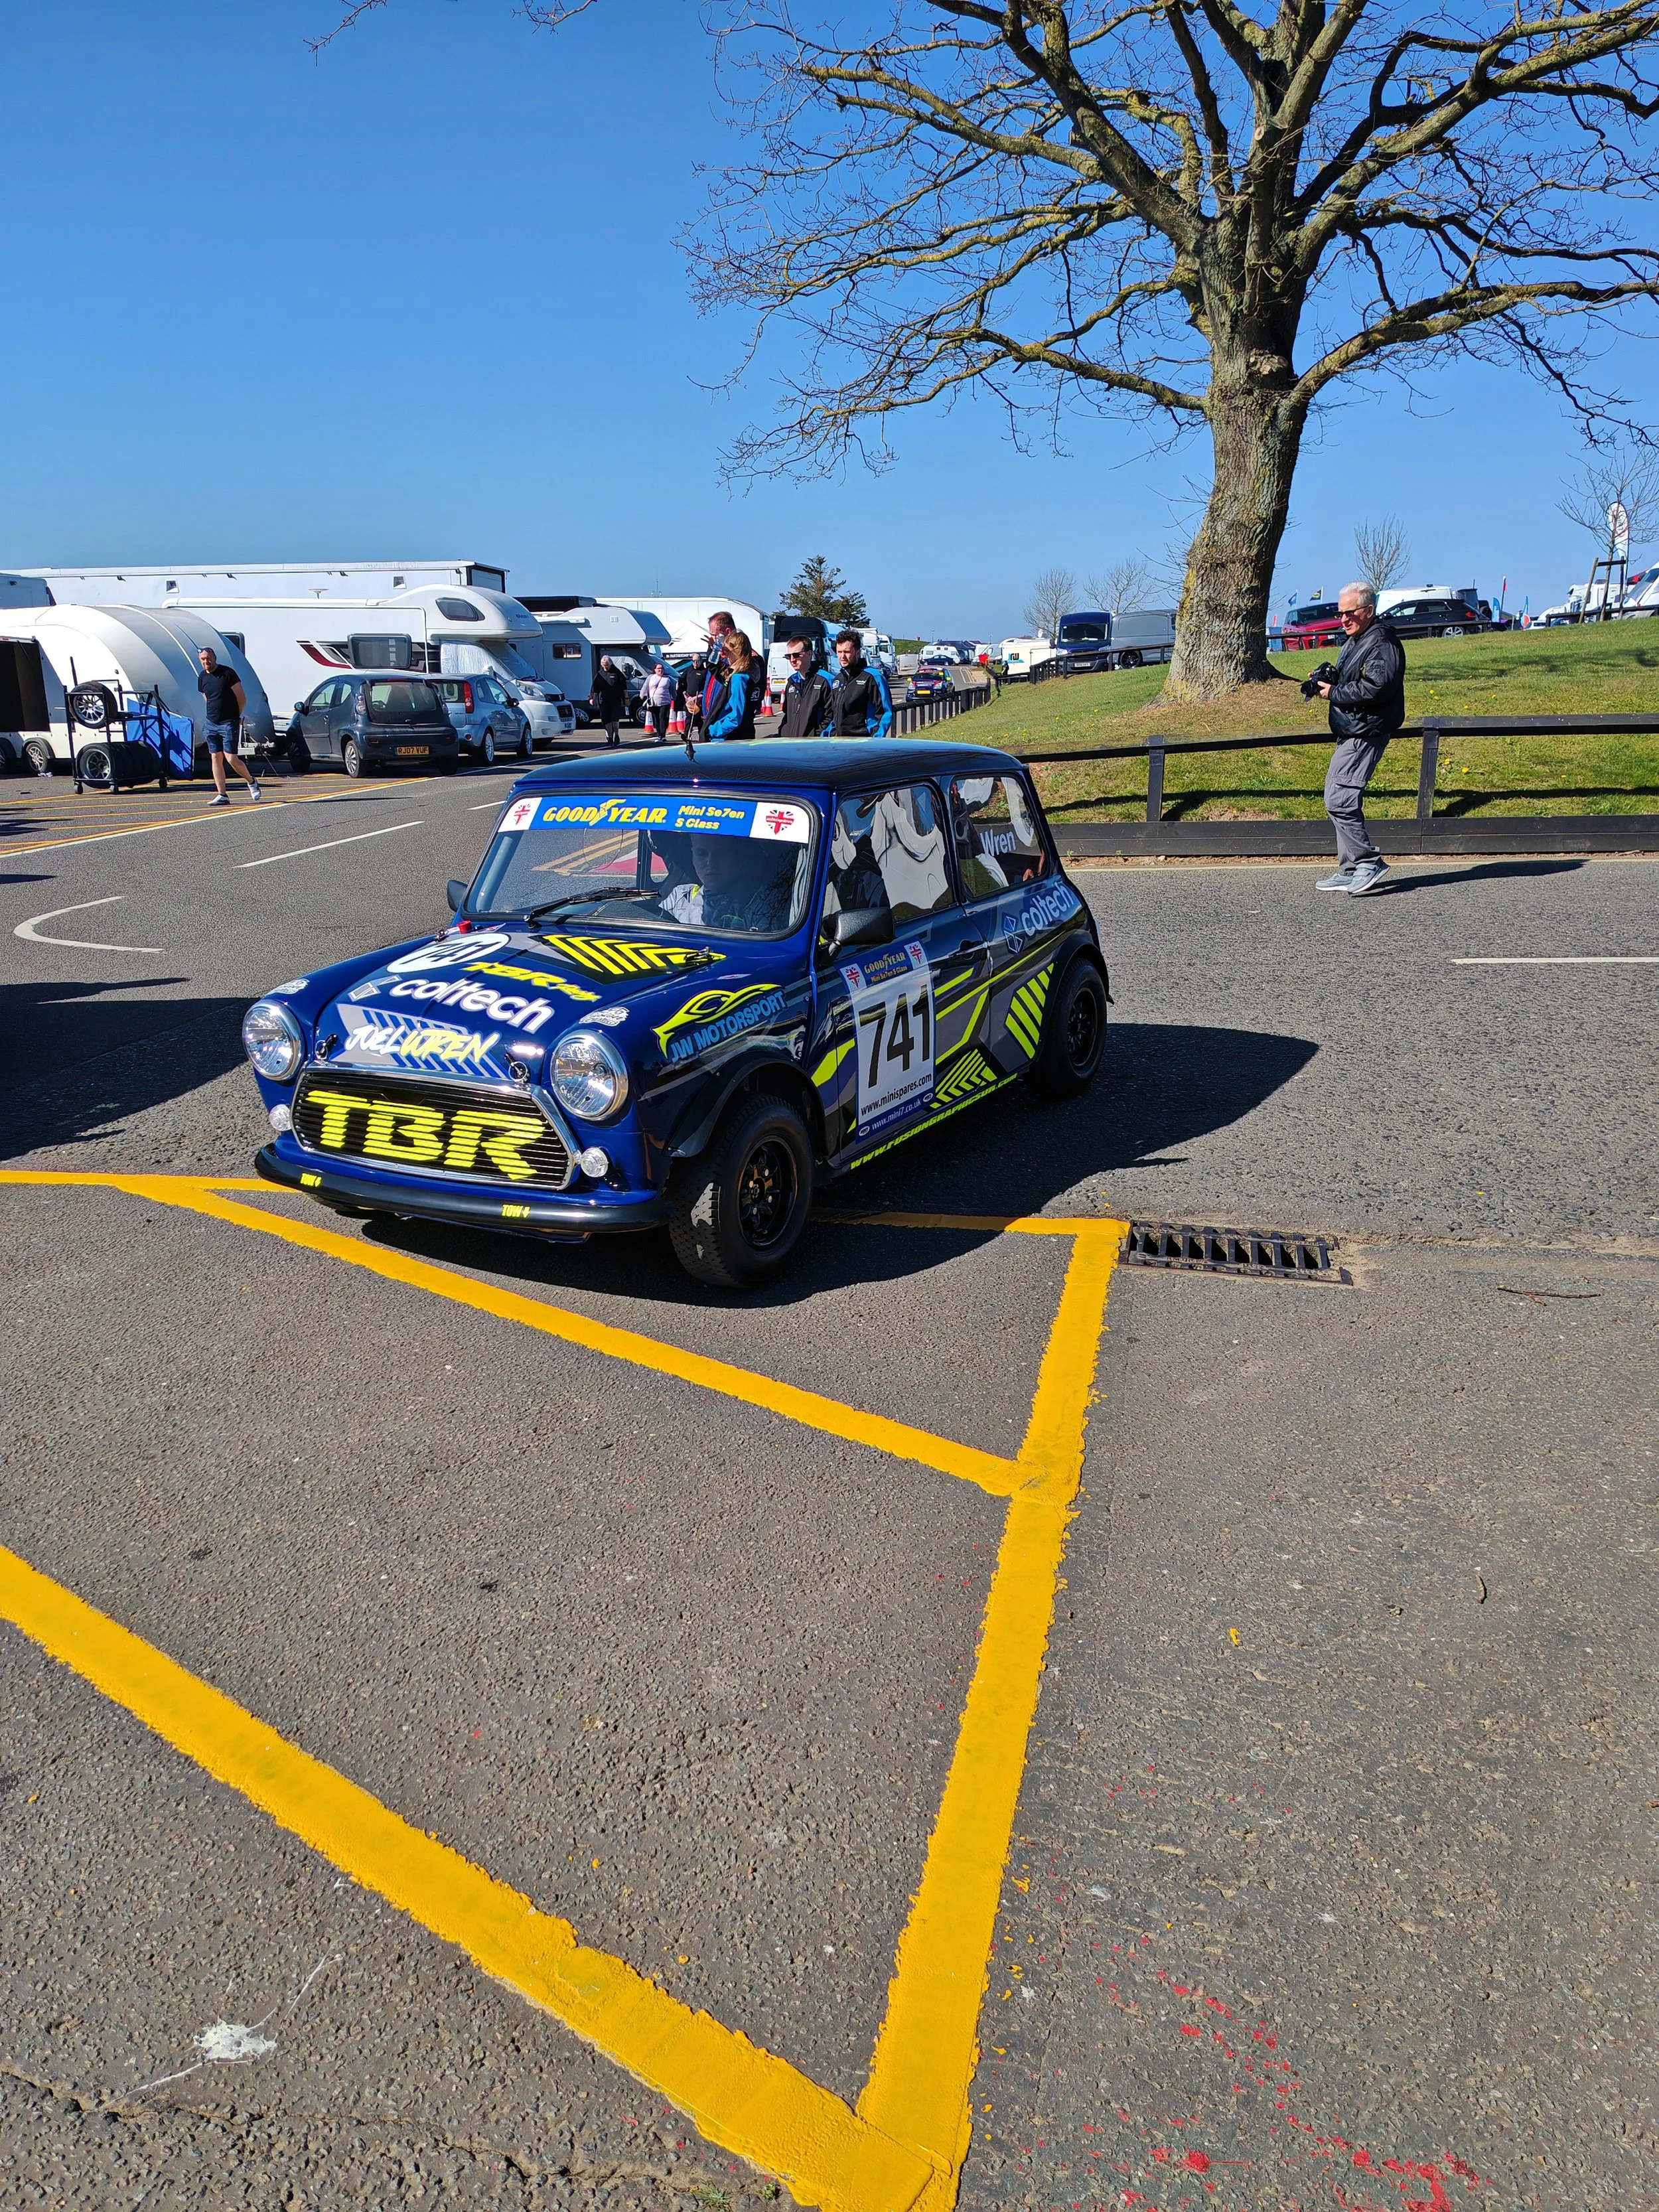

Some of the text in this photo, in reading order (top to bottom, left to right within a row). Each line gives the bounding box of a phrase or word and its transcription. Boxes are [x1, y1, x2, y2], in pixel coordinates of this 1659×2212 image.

[543, 799, 666, 826] GOODYEAR
[675, 818, 720, 830] S Class
[678, 805, 745, 820] Mini Se7en
[979, 829, 1017, 857] Wren
[1022, 881, 1074, 936] coltech
[463, 962, 566, 988] TBR
[864, 952, 906, 974] GOODYEAR
[390, 979, 555, 1034] coltech
[670, 991, 786, 1062] JW MOTORSPORT
[859, 984, 930, 1088] 741
[345, 1025, 500, 1063] JOEL WREN
[861, 1072, 932, 1116] www.minispares.com
[871, 1099, 922, 1130] www.mini7.co.uk
[305, 1090, 545, 1181] TBR
[300, 1173, 314, 1185] TOW
[502, 1205, 522, 1217] TOW
